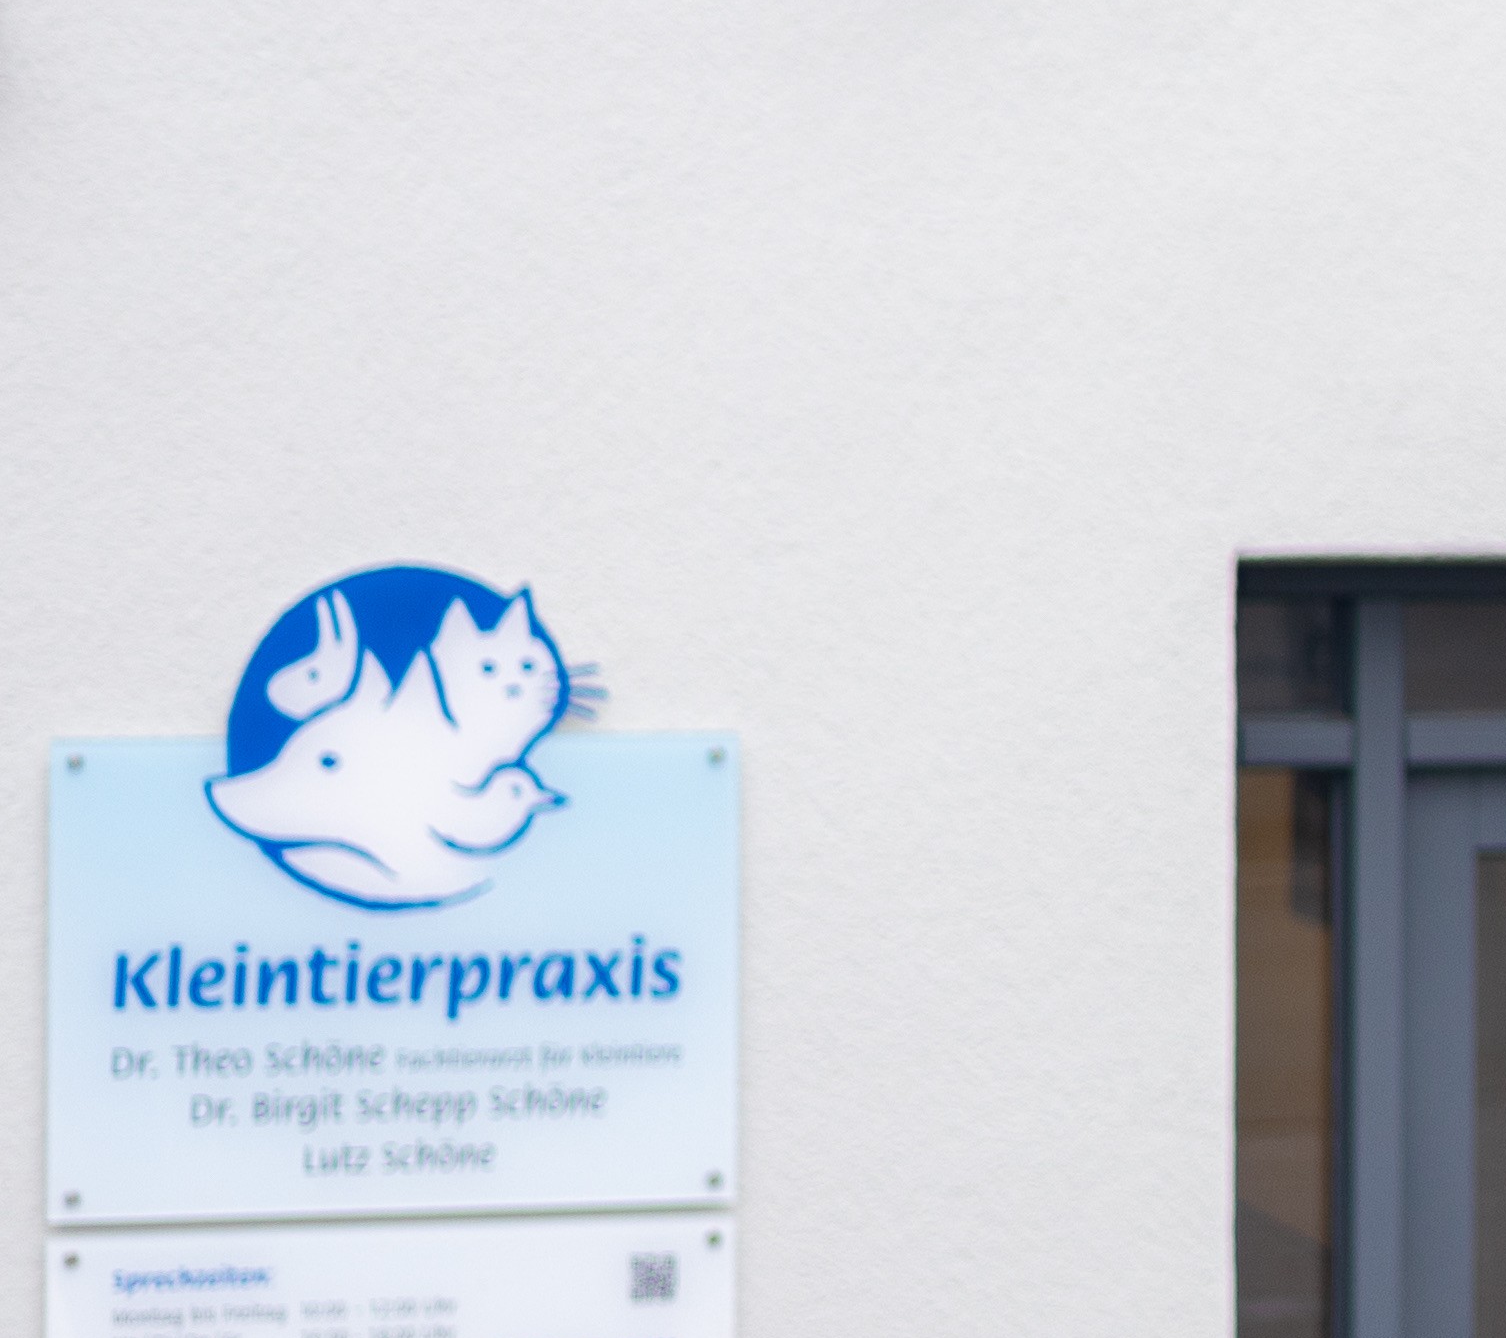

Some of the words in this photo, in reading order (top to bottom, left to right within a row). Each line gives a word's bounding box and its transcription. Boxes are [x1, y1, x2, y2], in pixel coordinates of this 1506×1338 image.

[114, 934, 682, 1021] Kleintierpraxis
[111, 1047, 157, 1079] Dr.
[176, 1044, 253, 1075] Theo
[266, 1042, 385, 1074] Schöne
[190, 1095, 237, 1126] Dr.
[252, 1093, 342, 1130] Birgit
[357, 1088, 477, 1125] Schepp
[490, 1084, 607, 1117] Schöne
[303, 1145, 370, 1174] Lutz
[382, 1140, 496, 1171] Schöne
